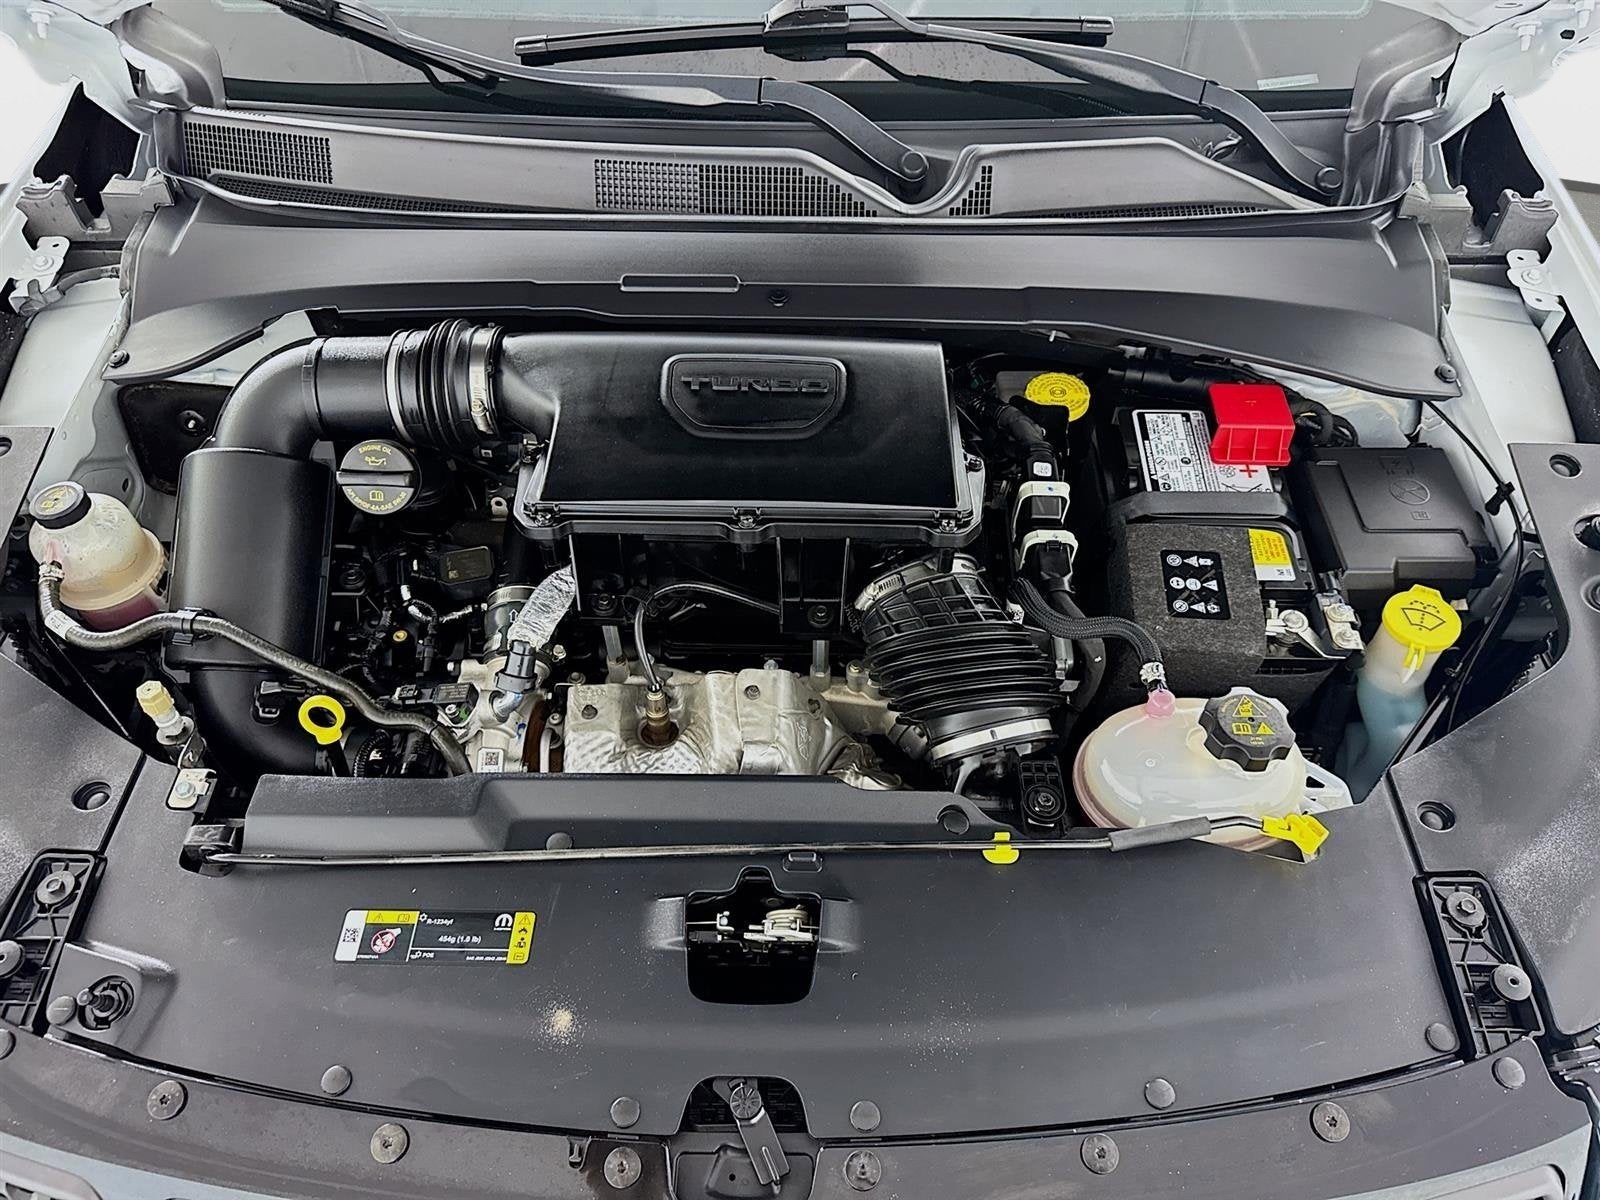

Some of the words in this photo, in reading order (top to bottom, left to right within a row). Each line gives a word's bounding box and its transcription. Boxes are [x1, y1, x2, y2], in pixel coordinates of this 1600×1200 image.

[681, 376, 830, 393] TURBO
[359, 445, 381, 454] ENGINE
[381, 446, 392, 455] OIL
[426, 918, 454, 926] R-1234yf
[438, 935, 456, 944] 454g
[471, 935, 482, 944] lb)
